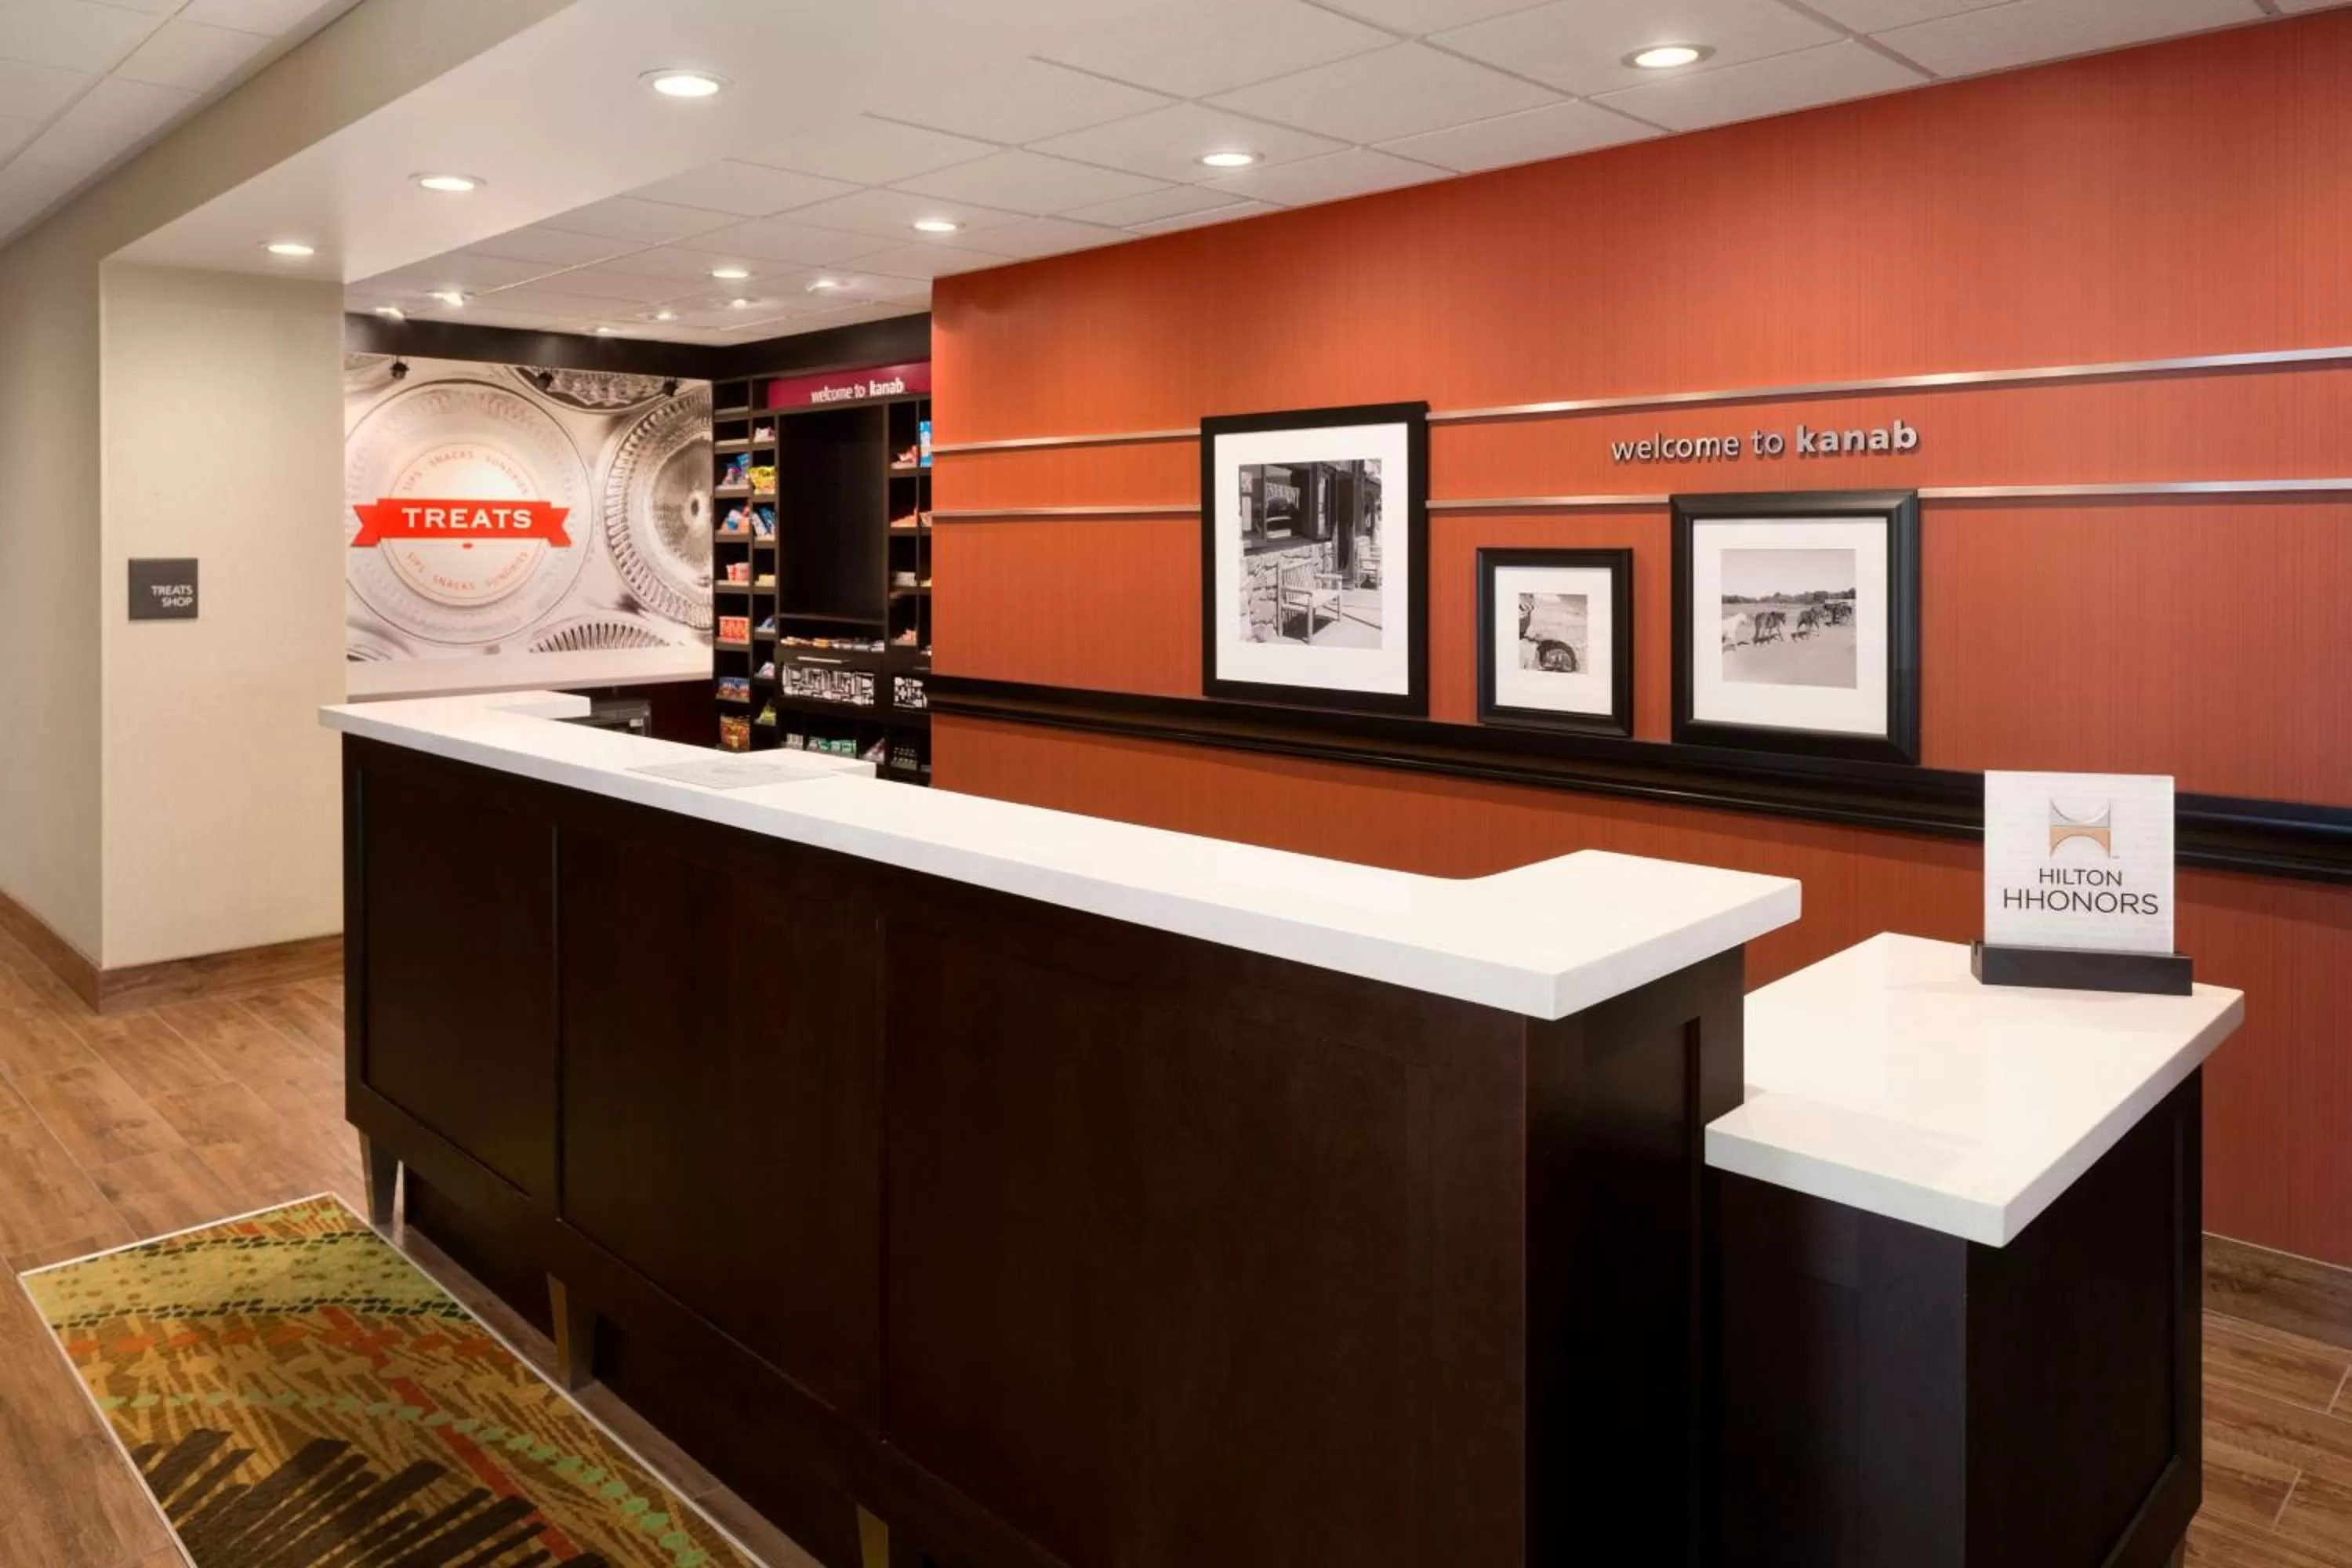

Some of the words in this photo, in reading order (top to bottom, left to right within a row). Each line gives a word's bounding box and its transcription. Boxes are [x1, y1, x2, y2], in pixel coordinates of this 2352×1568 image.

[811, 385, 853, 403] welcome
[855, 383, 866, 398] to
[869, 376, 904, 396] kanab
[1611, 433, 1741, 461] welcome
[1751, 430, 1784, 454] to
[1795, 420, 1919, 452] kanab
[401, 507, 532, 529] TREATS
[151, 585, 193, 596] TREATS
[162, 597, 193, 608] SHOP
[2038, 868, 2123, 887] HILTON
[2003, 888, 2159, 916] HHONORS
